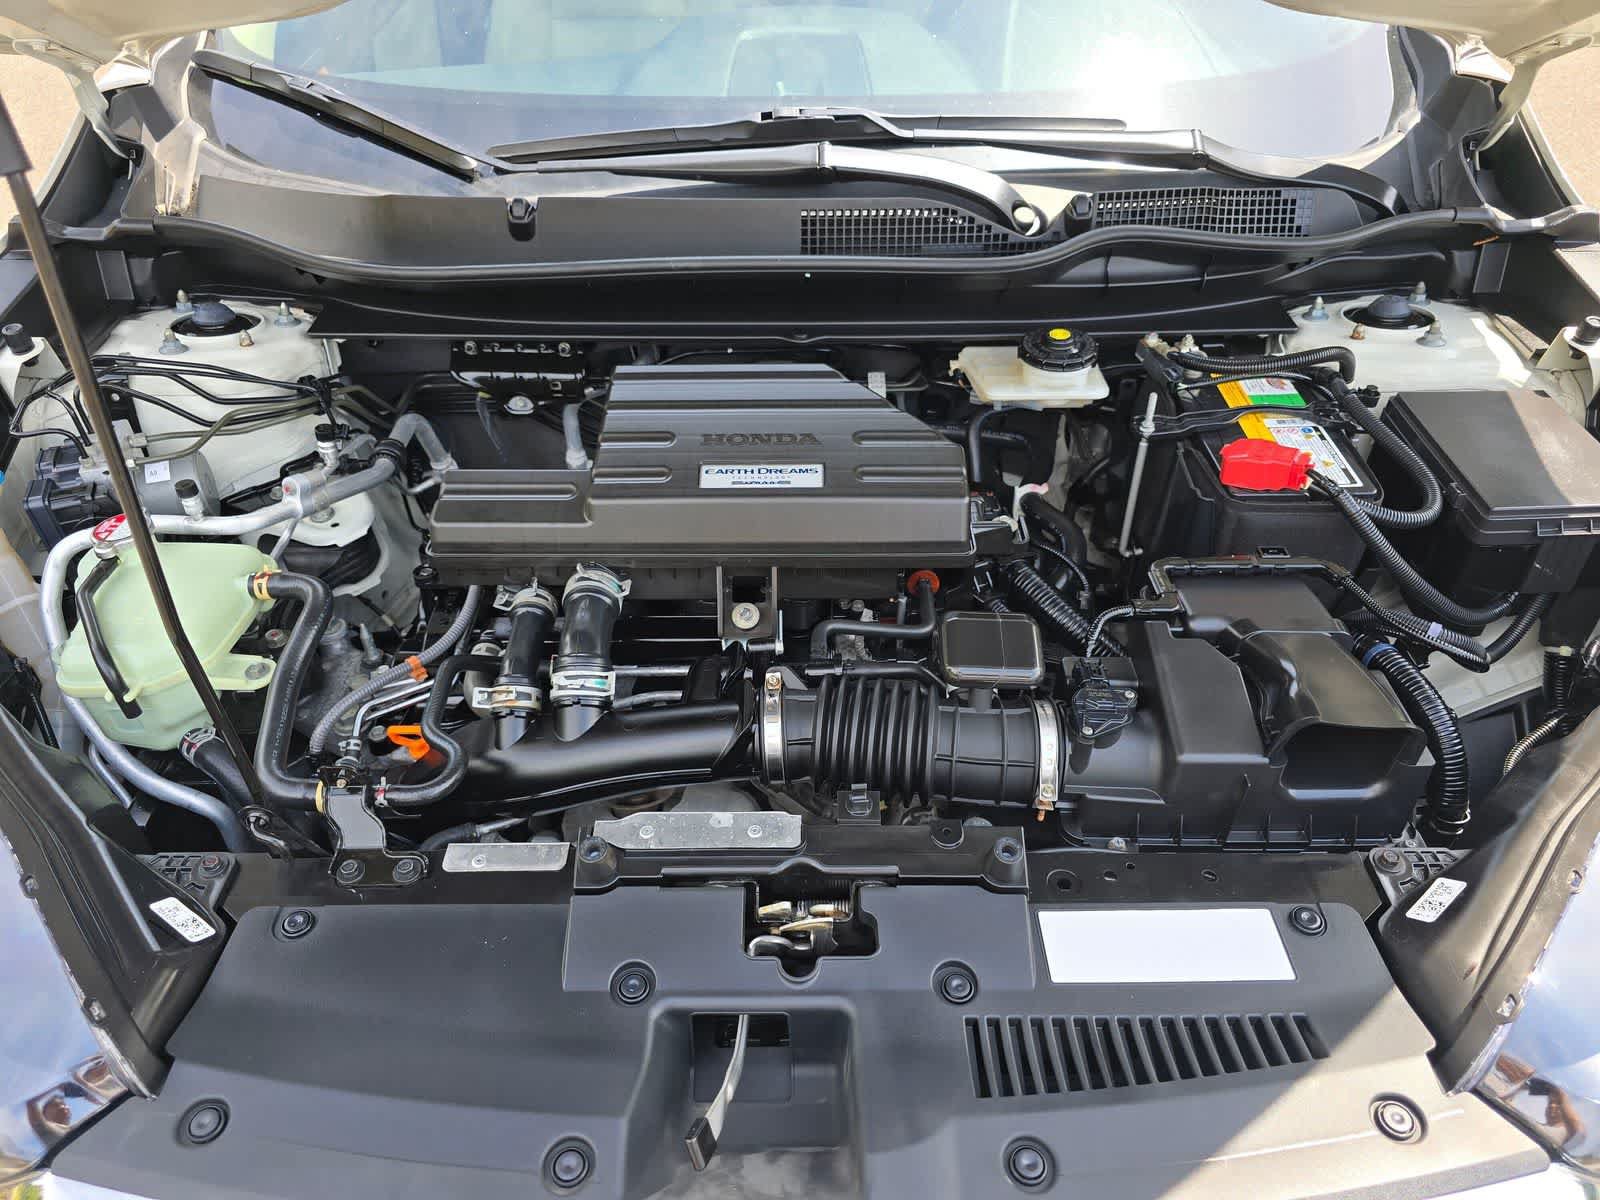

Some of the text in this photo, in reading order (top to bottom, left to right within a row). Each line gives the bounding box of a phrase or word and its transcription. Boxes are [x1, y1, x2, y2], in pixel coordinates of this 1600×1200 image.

[701, 432, 822, 446] HONDA
[704, 467, 819, 475] EARTH DREAMS
